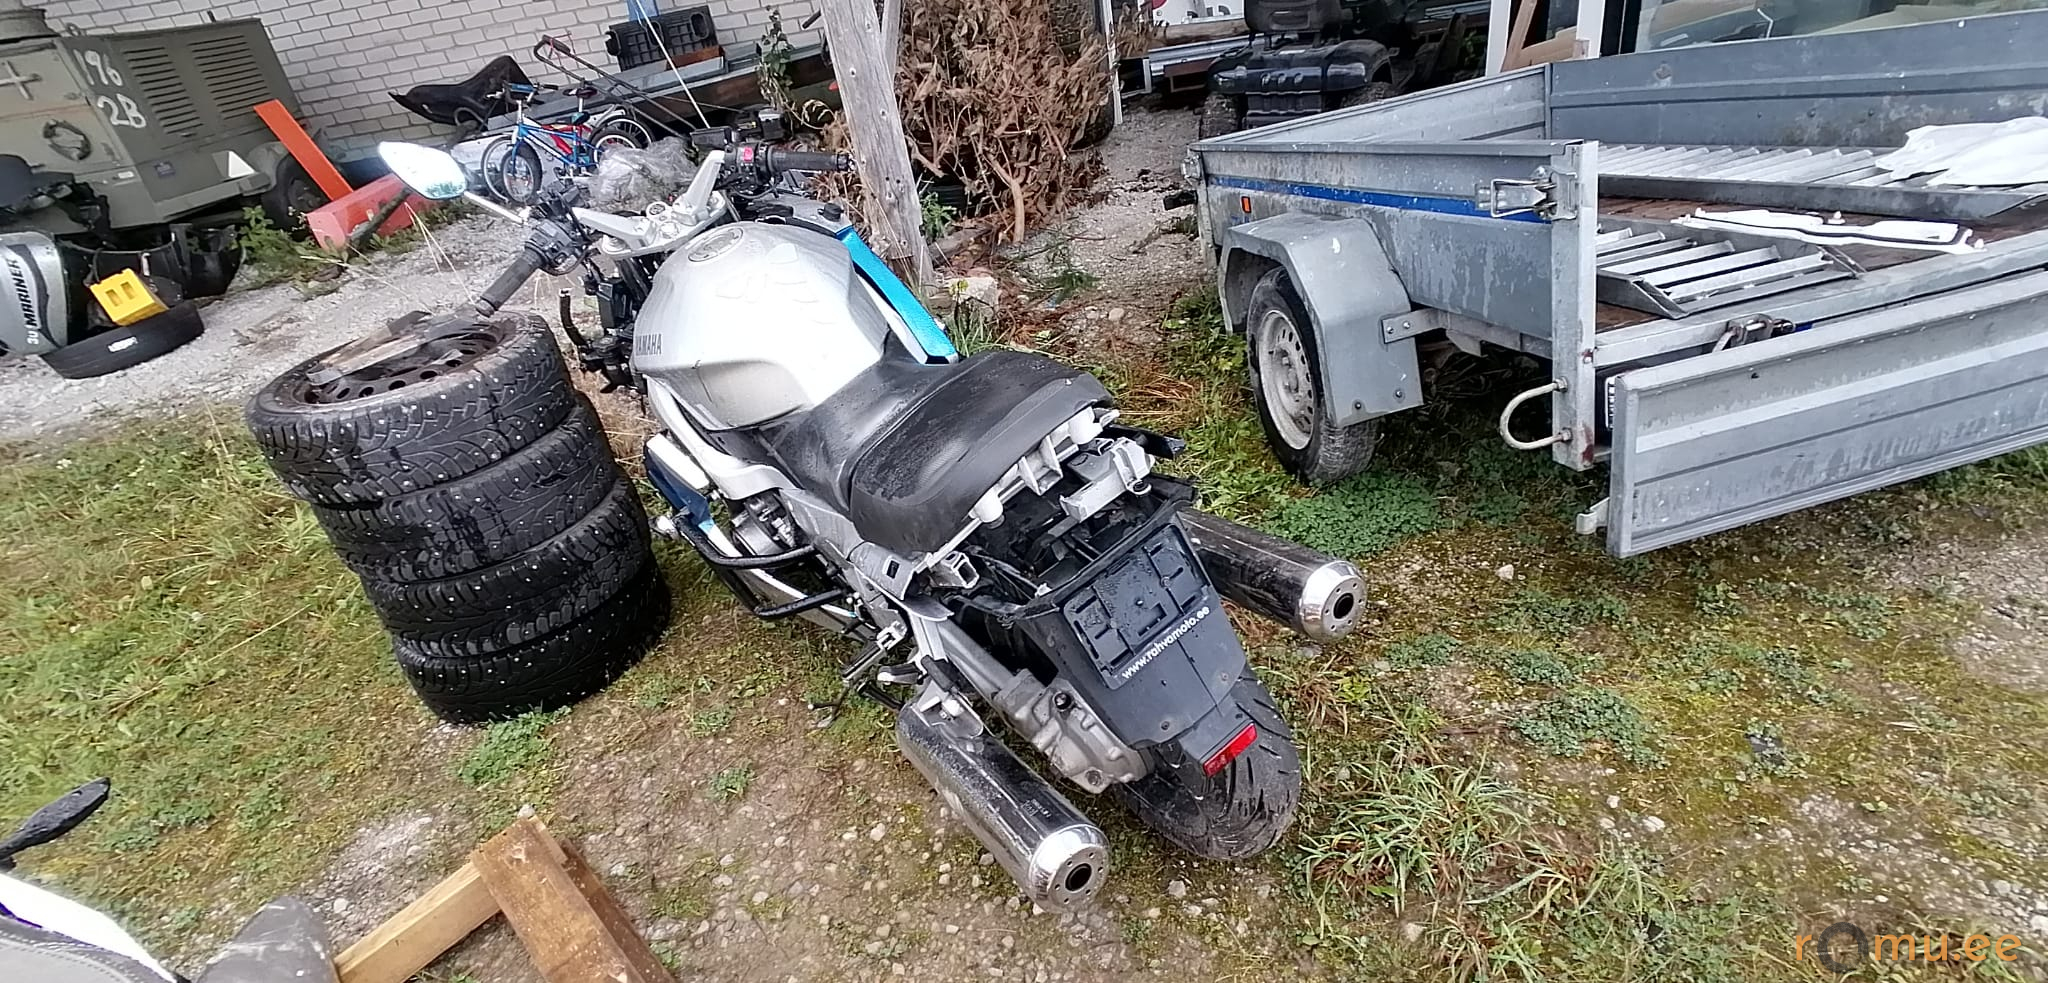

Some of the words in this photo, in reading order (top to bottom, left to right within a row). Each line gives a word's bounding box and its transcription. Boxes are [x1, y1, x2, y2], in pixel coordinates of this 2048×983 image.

[75, 49, 123, 87] 196
[97, 93, 147, 129] 2B
[6, 258, 38, 328] MARINER
[635, 333, 662, 356] YAMAHA
[1122, 606, 1210, 679] www.rahvamoto.ee
